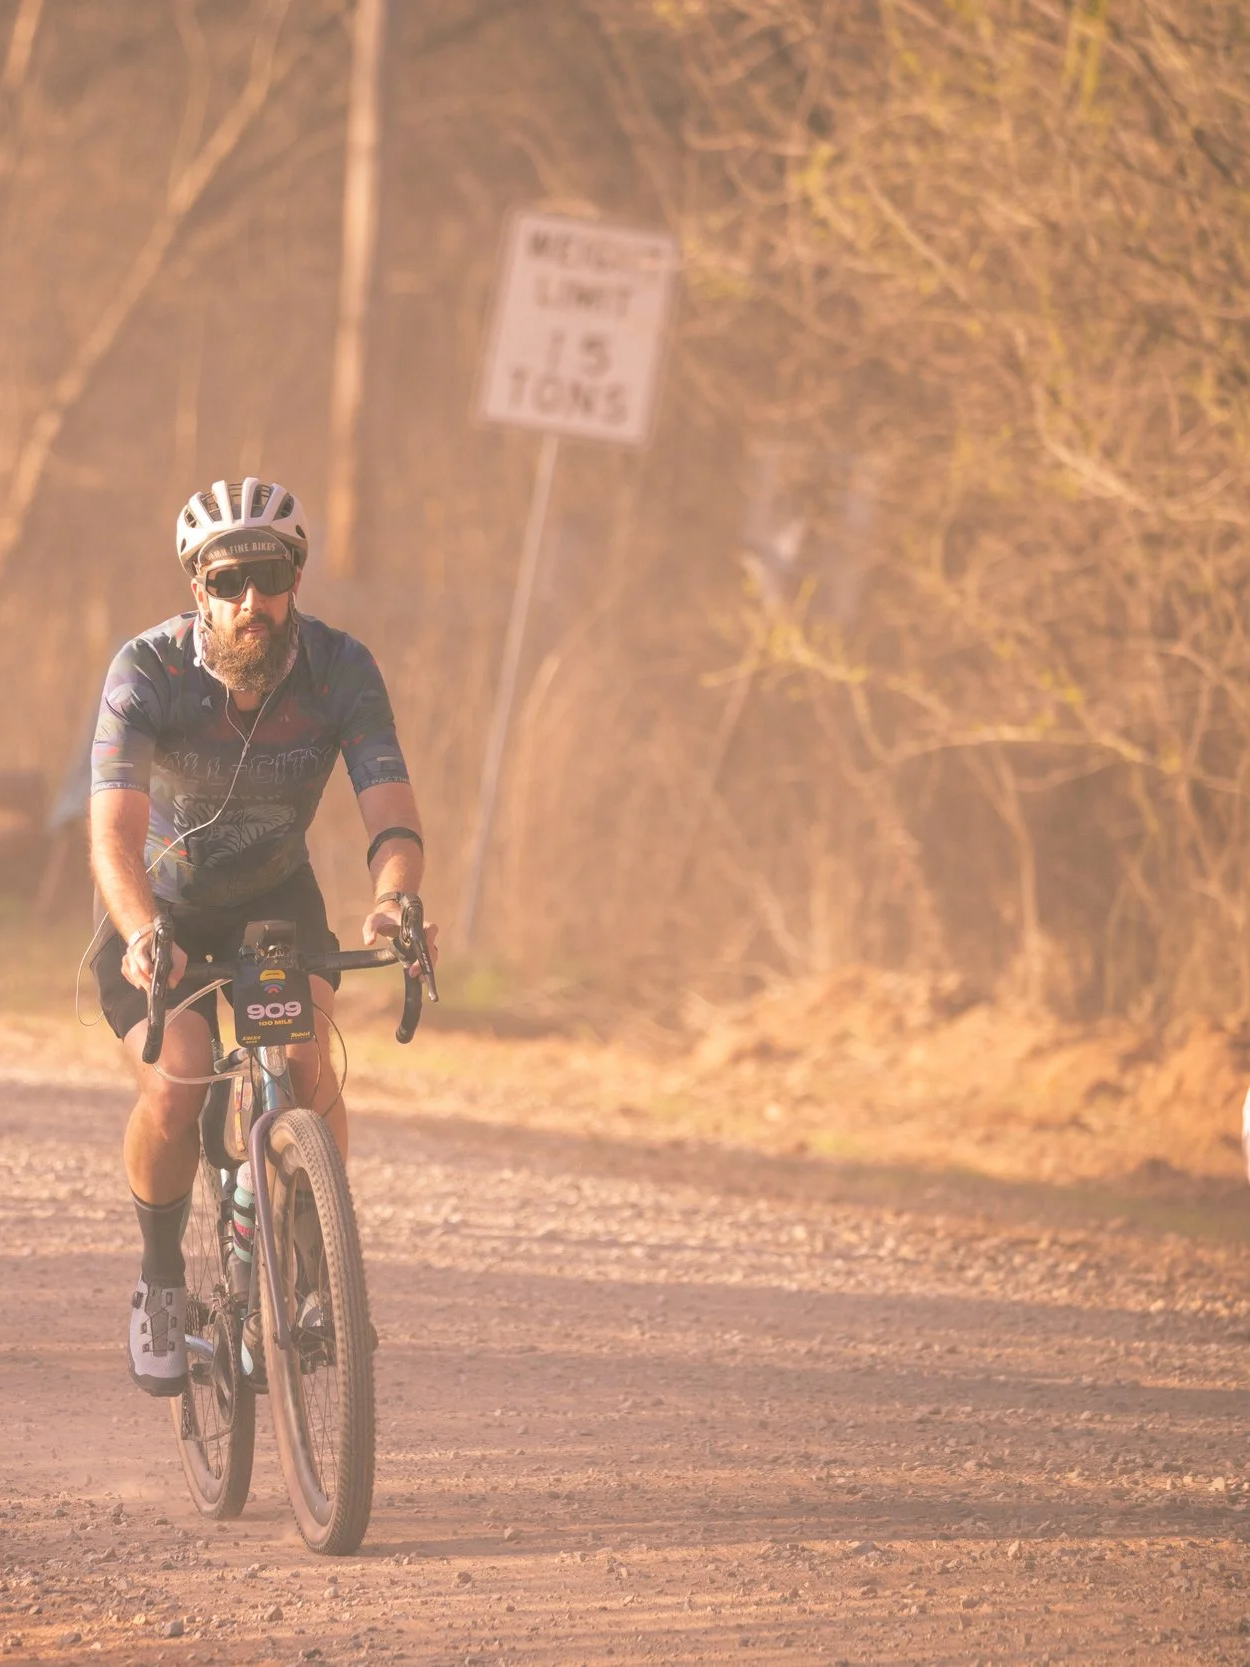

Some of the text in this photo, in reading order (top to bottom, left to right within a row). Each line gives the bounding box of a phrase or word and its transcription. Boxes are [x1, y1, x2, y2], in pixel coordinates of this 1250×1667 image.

[533, 274, 634, 319] LIMIT
[546, 328, 616, 378] 15
[507, 365, 629, 427] TONS
[228, 542, 250, 555] FINE
[252, 542, 277, 552] BIKES
[246, 1001, 302, 1020] 909
